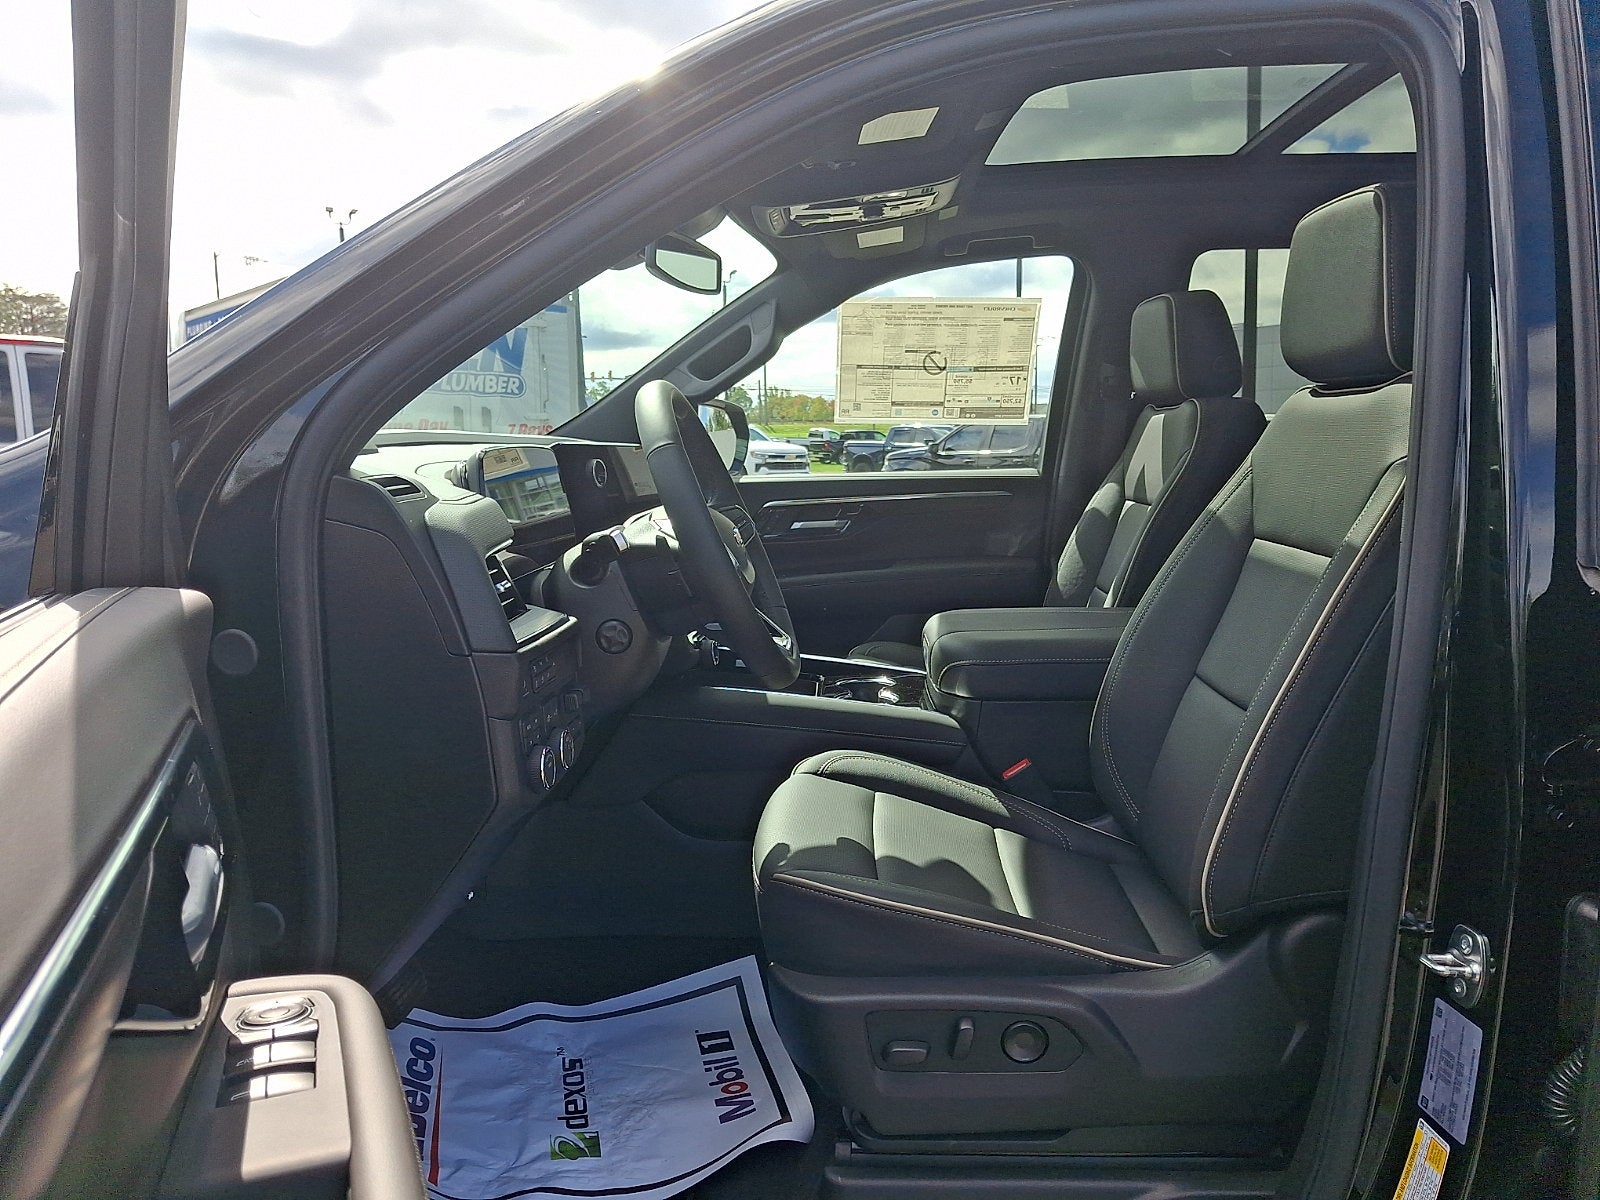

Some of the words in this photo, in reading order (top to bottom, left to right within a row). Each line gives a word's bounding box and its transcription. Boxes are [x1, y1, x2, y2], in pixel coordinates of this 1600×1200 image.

[440, 372, 520, 394] LUMBER
[698, 1035, 732, 1050] 1
[557, 1057, 589, 1129] dexos
[703, 1056, 757, 1124] Mobil
